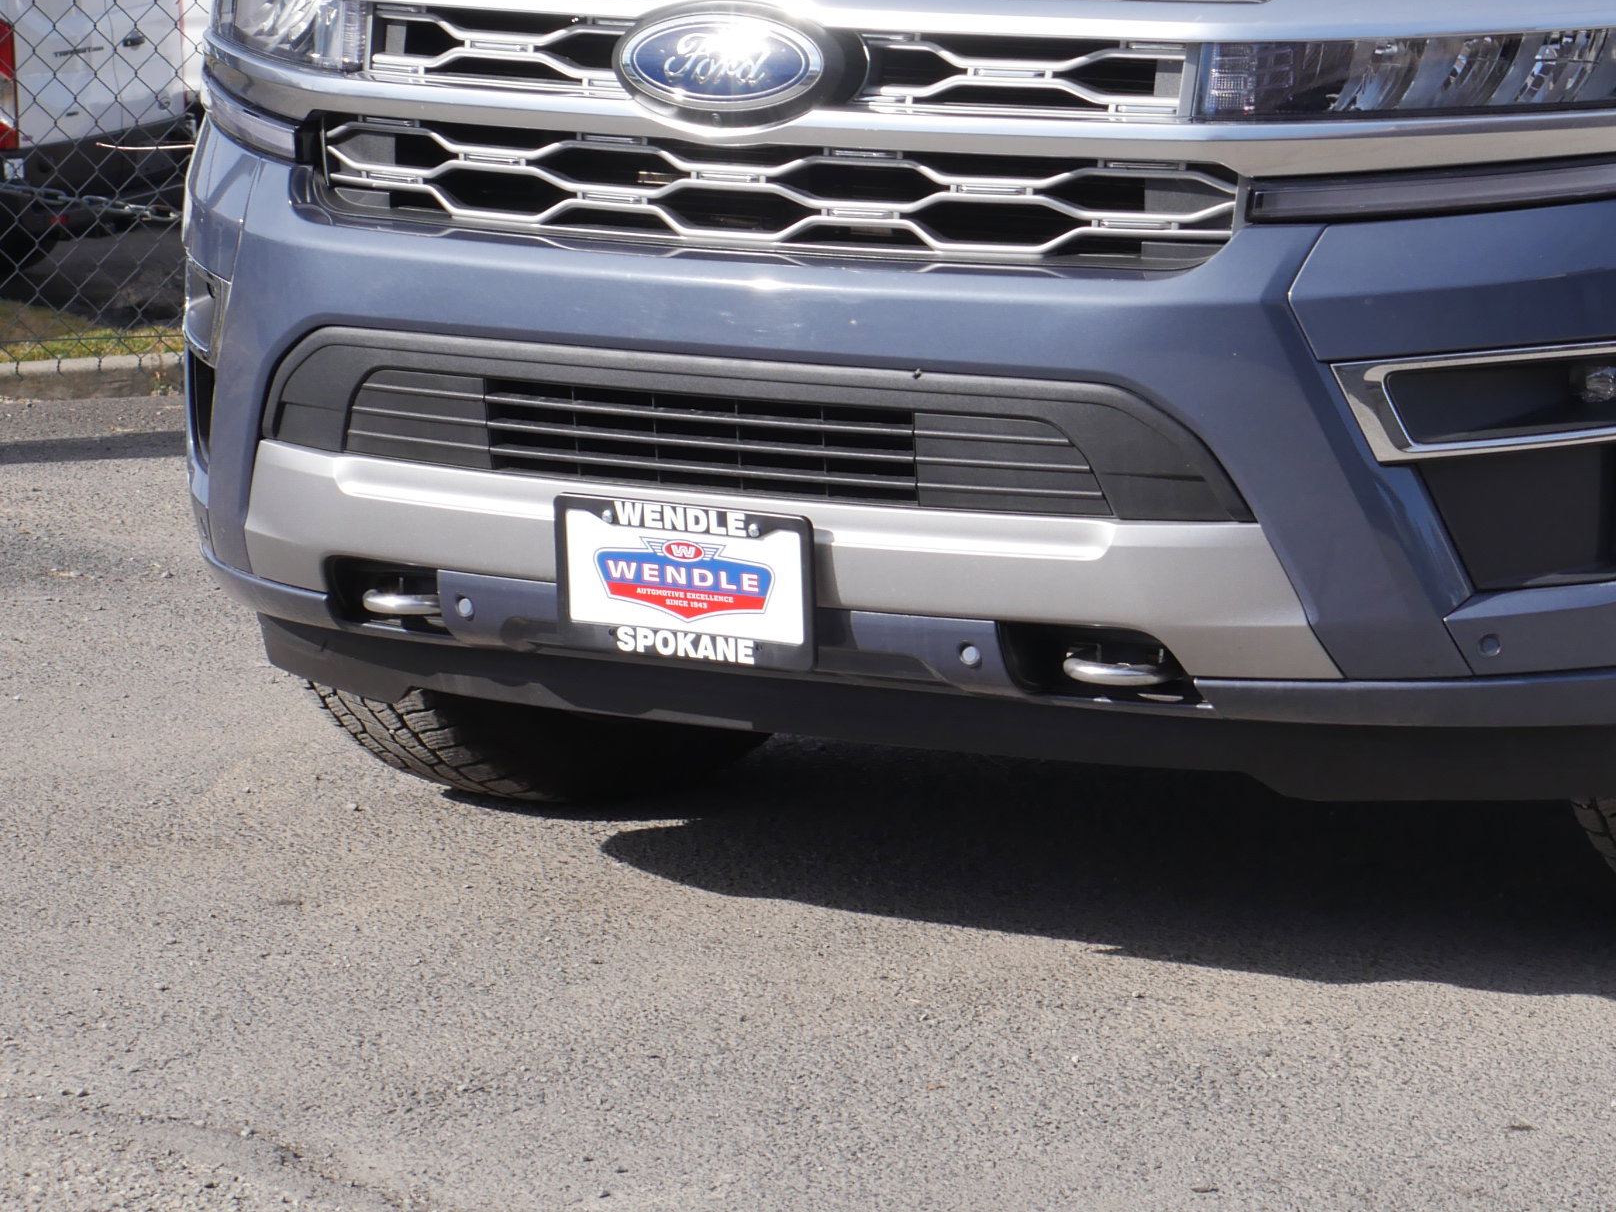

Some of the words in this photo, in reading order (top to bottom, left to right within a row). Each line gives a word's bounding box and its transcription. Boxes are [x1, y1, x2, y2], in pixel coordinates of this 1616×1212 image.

[664, 32, 771, 85] Ford
[614, 500, 748, 538] WENDLE
[670, 543, 698, 559] W
[605, 559, 760, 593] WENDLE
[636, 587, 685, 599] AUTOMOTIVE
[686, 592, 734, 603] EXCELLENCE
[665, 599, 689, 608] SINCE
[689, 600, 708, 609] 1943
[616, 626, 755, 665] SPOKANE
